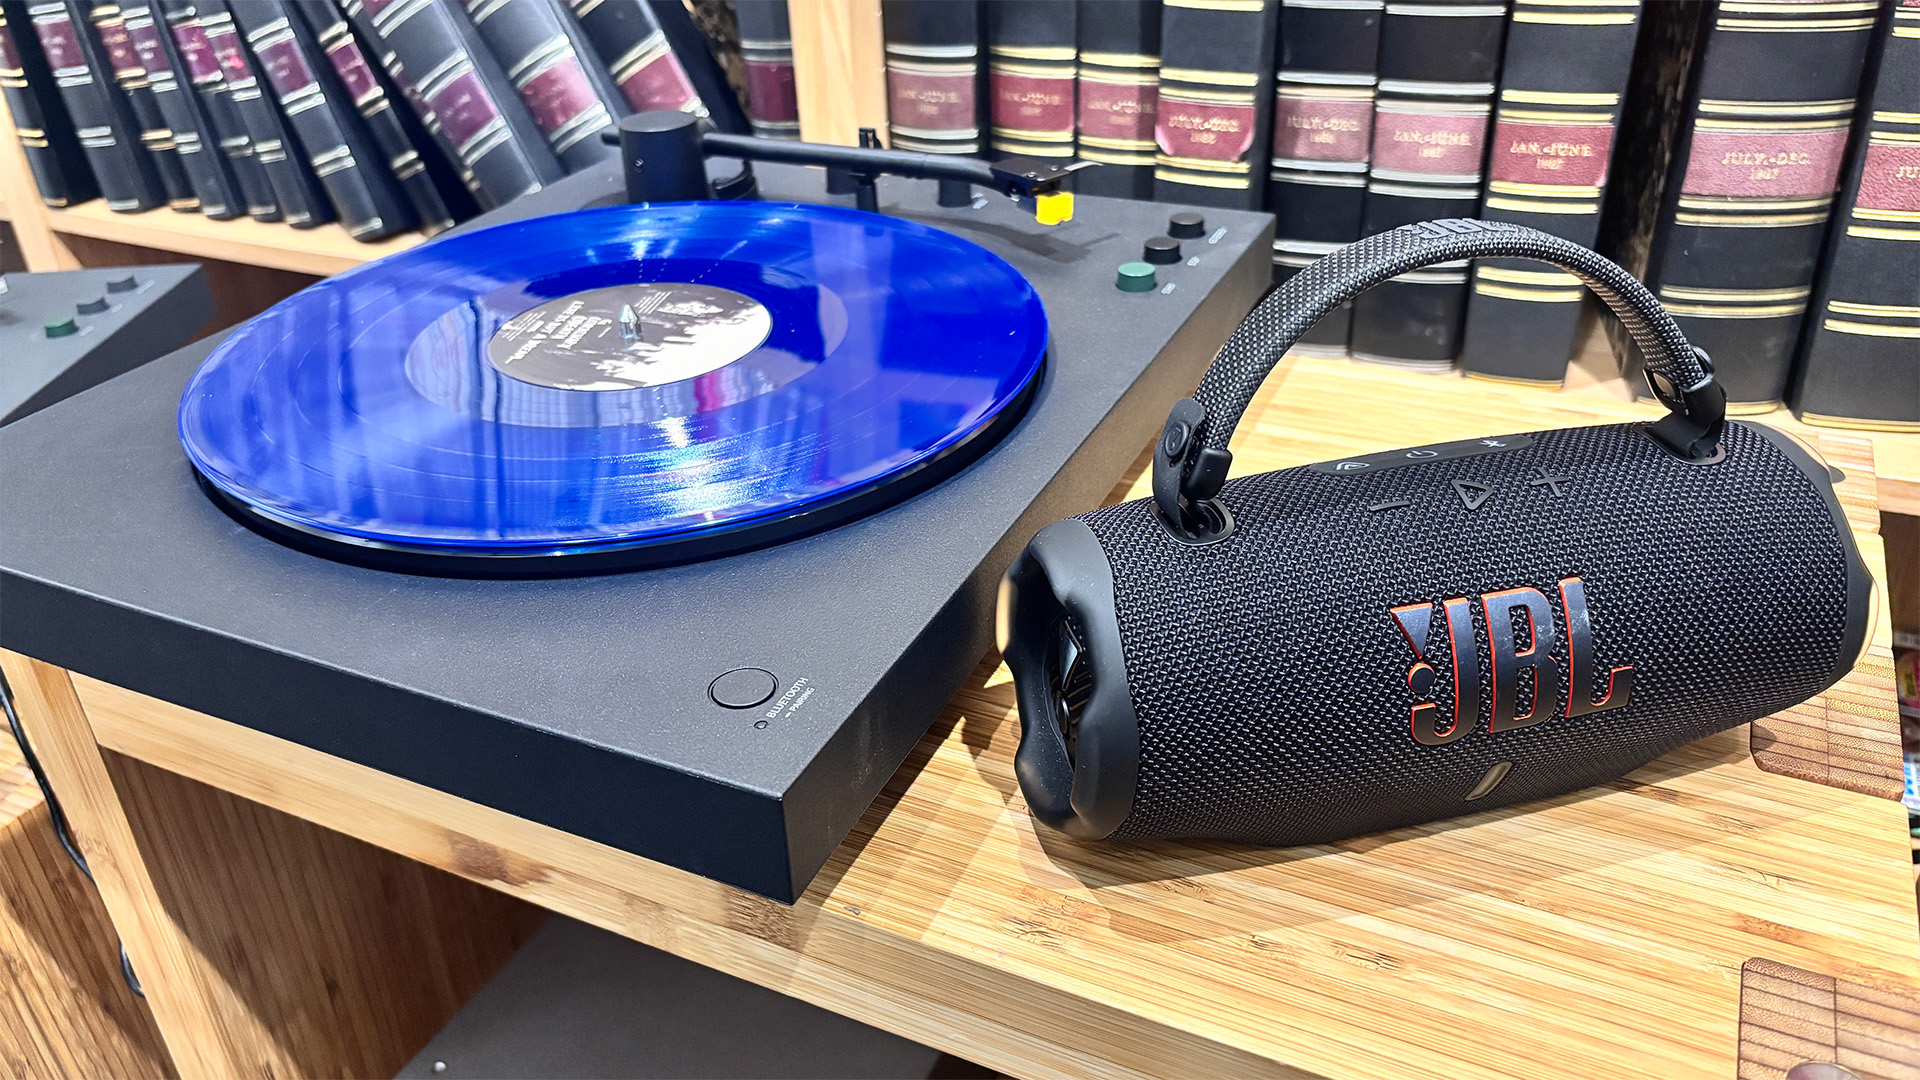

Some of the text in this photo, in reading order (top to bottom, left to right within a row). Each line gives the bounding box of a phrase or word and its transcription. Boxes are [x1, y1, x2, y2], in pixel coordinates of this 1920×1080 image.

[1895, 165, 1920, 179] JU
[1400, 217, 1517, 240] JBL
[1390, 575, 1634, 746] JBL
[765, 676, 809, 719] BLUETOOTH
[788, 686, 816, 712] PAIRING
